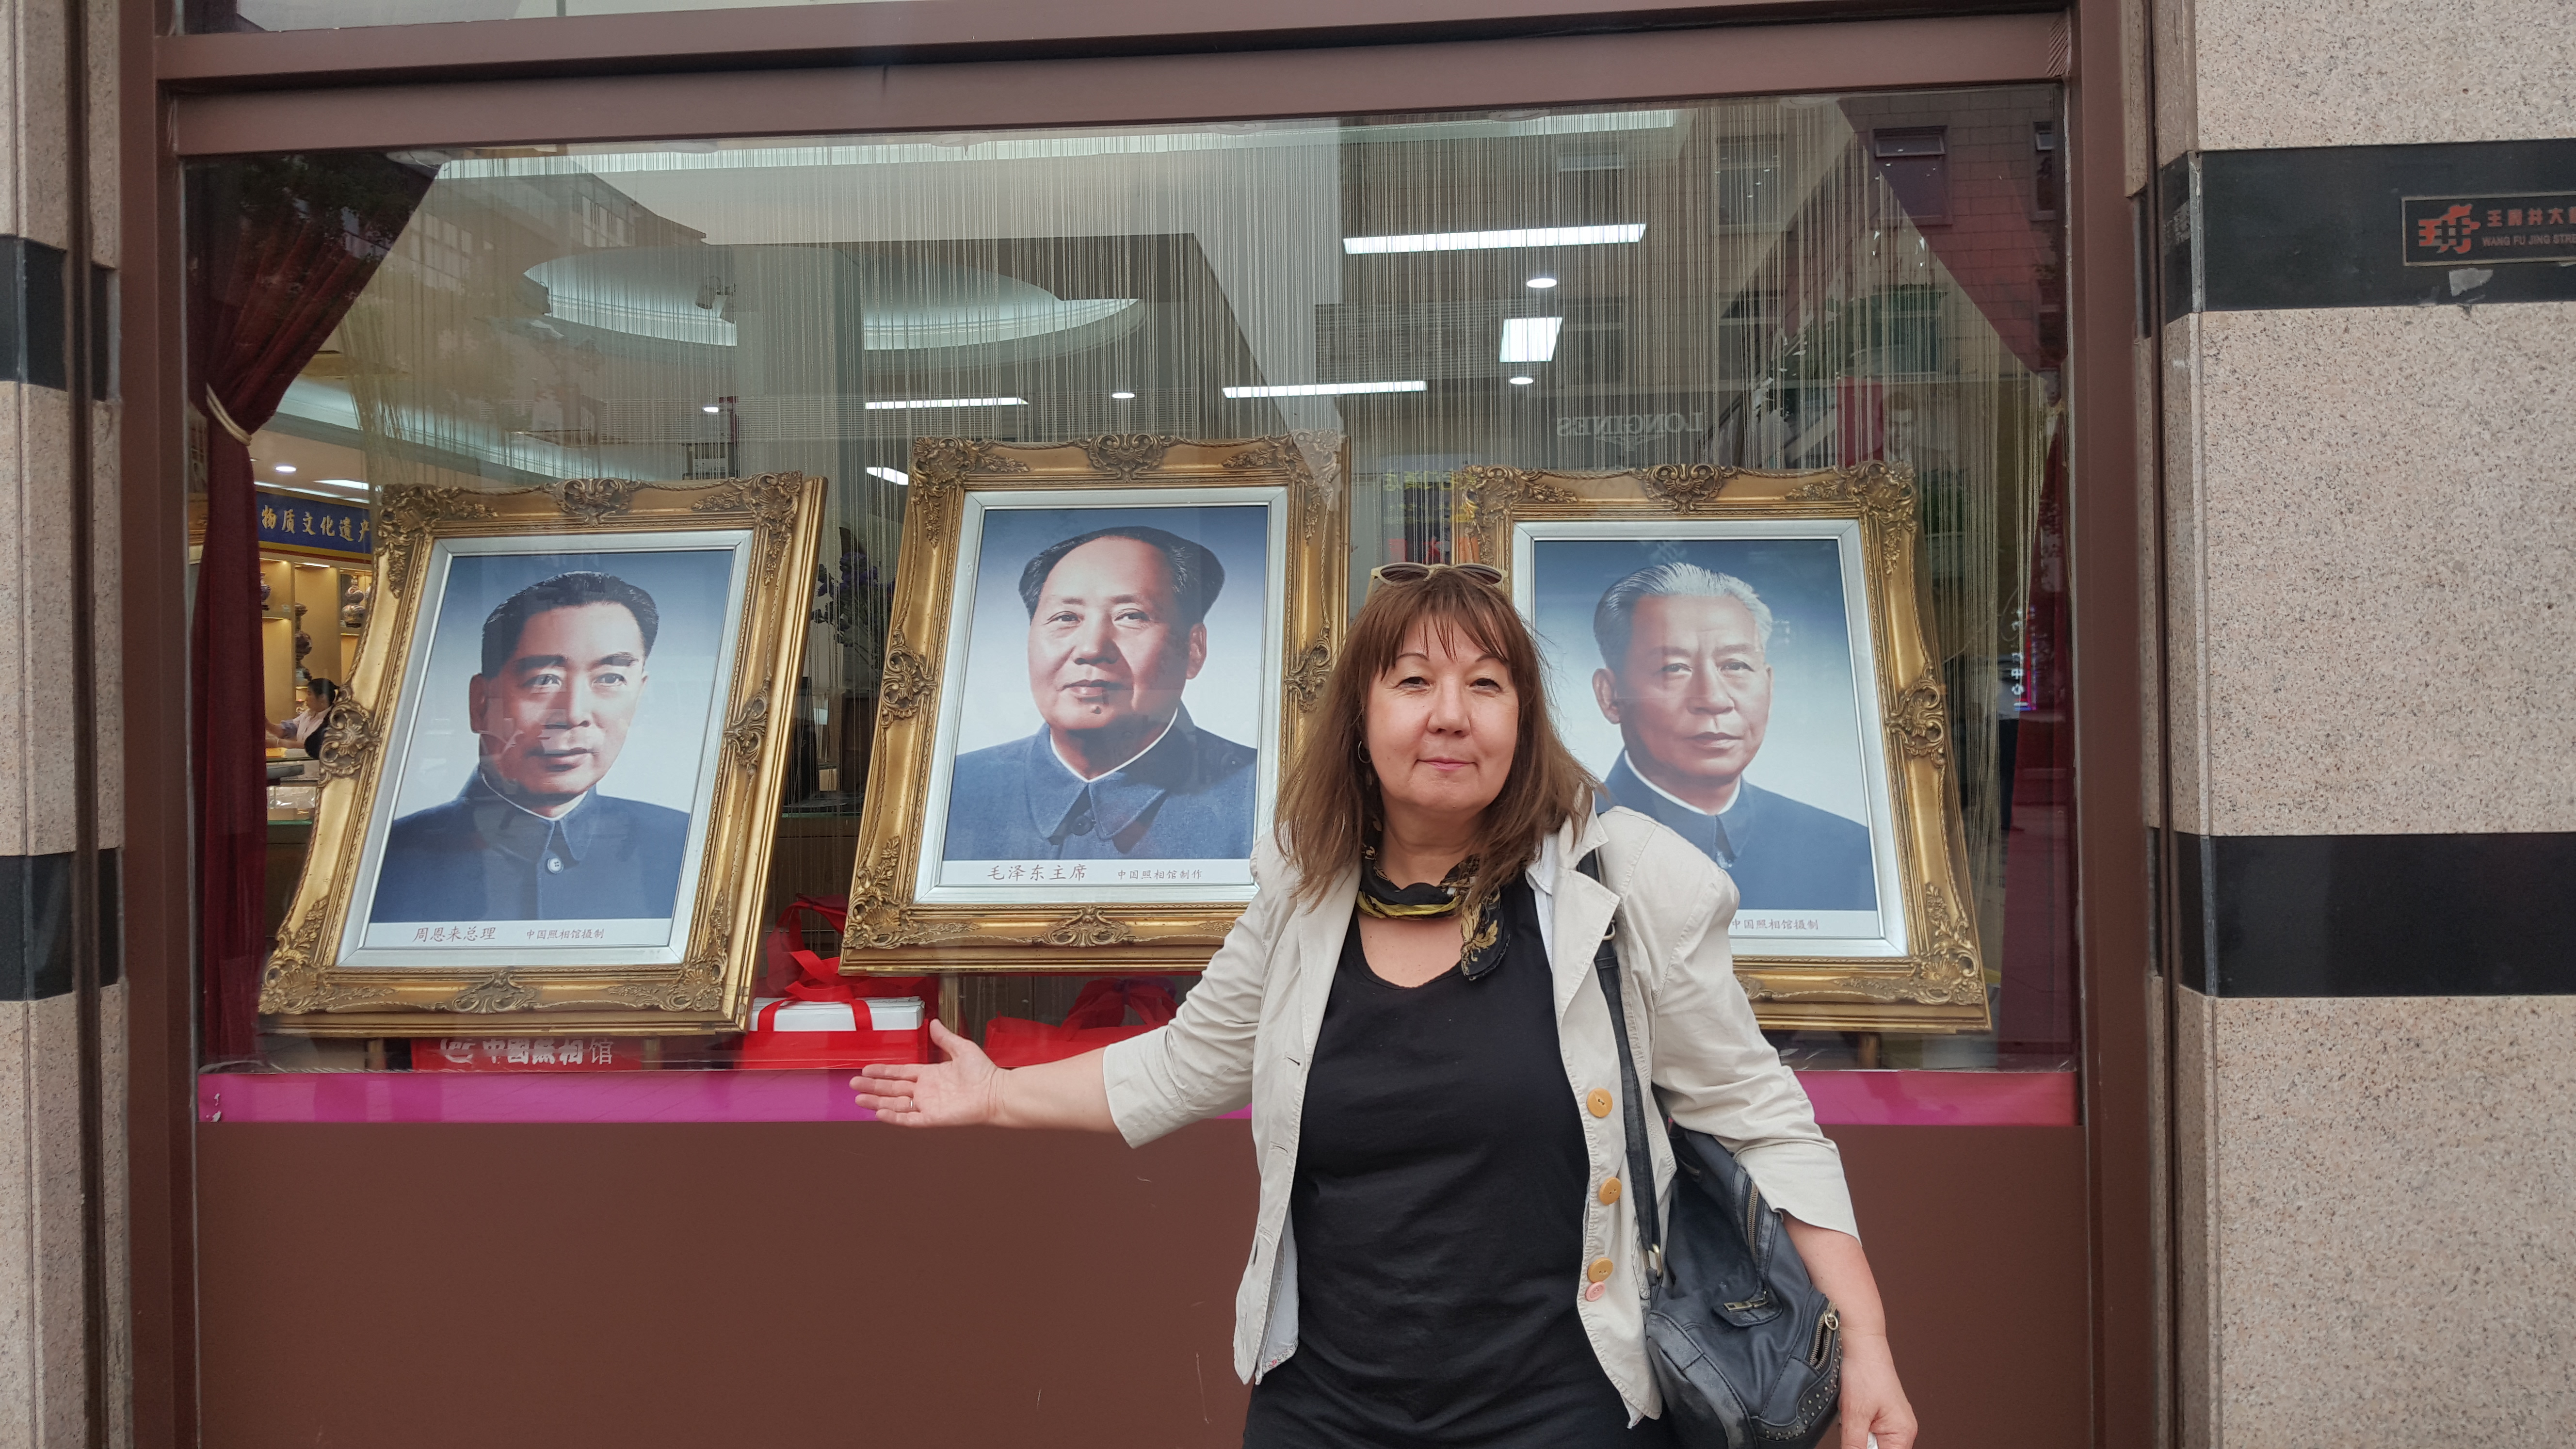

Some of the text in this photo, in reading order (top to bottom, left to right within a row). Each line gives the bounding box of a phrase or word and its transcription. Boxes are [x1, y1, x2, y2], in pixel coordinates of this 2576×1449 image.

[2482, 236, 2510, 247] WANG
[2513, 235, 2525, 246] FU
[2528, 234, 2551, 245] JING
[987, 864, 1203, 882] 毛泽东主席 中国照相馆制作
[412, 926, 497, 943] 周恩来总理
